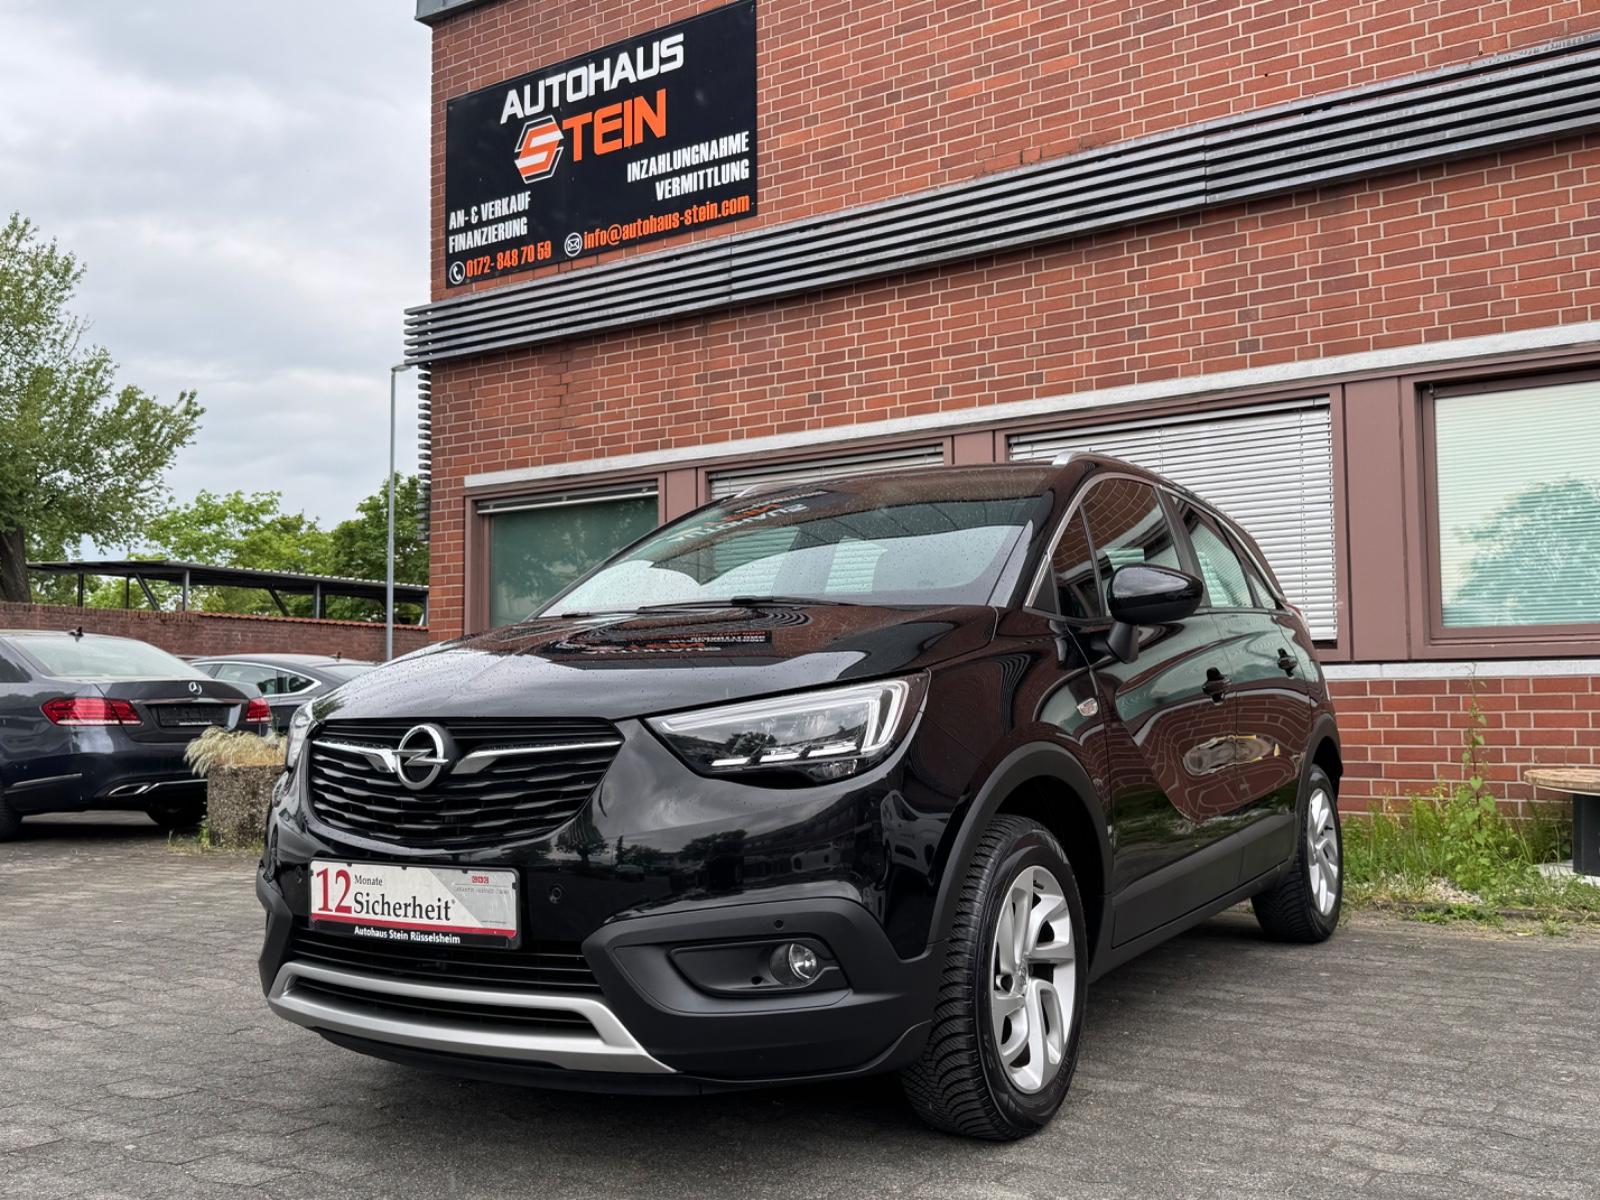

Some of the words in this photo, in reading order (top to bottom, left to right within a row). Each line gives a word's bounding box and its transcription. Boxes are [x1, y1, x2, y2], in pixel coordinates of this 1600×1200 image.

[500, 33, 684, 125] AUTOHAUS
[515, 88, 667, 178] STEIN
[627, 131, 749, 183] INZAHLUNGNAHME
[655, 159, 750, 201] VERMITTLUNG
[449, 209, 469, 230] AN-
[481, 190, 531, 221] VERKAUF
[583, 195, 750, 250] info@autohaus-stein.com
[449, 216, 528, 254] FINANZIERUNG
[466, 255, 495, 278] 0172-
[496, 248, 519, 270] 848
[521, 244, 535, 264] 70
[537, 240, 552, 261] 59
[316, 867, 352, 914] 12
[354, 874, 383, 886] Monate
[353, 891, 451, 921] Sicherheit
[354, 925, 388, 939] Autohaus
[388, 930, 409, 941] Stein
[410, 930, 461, 944] Rüsselsheim
